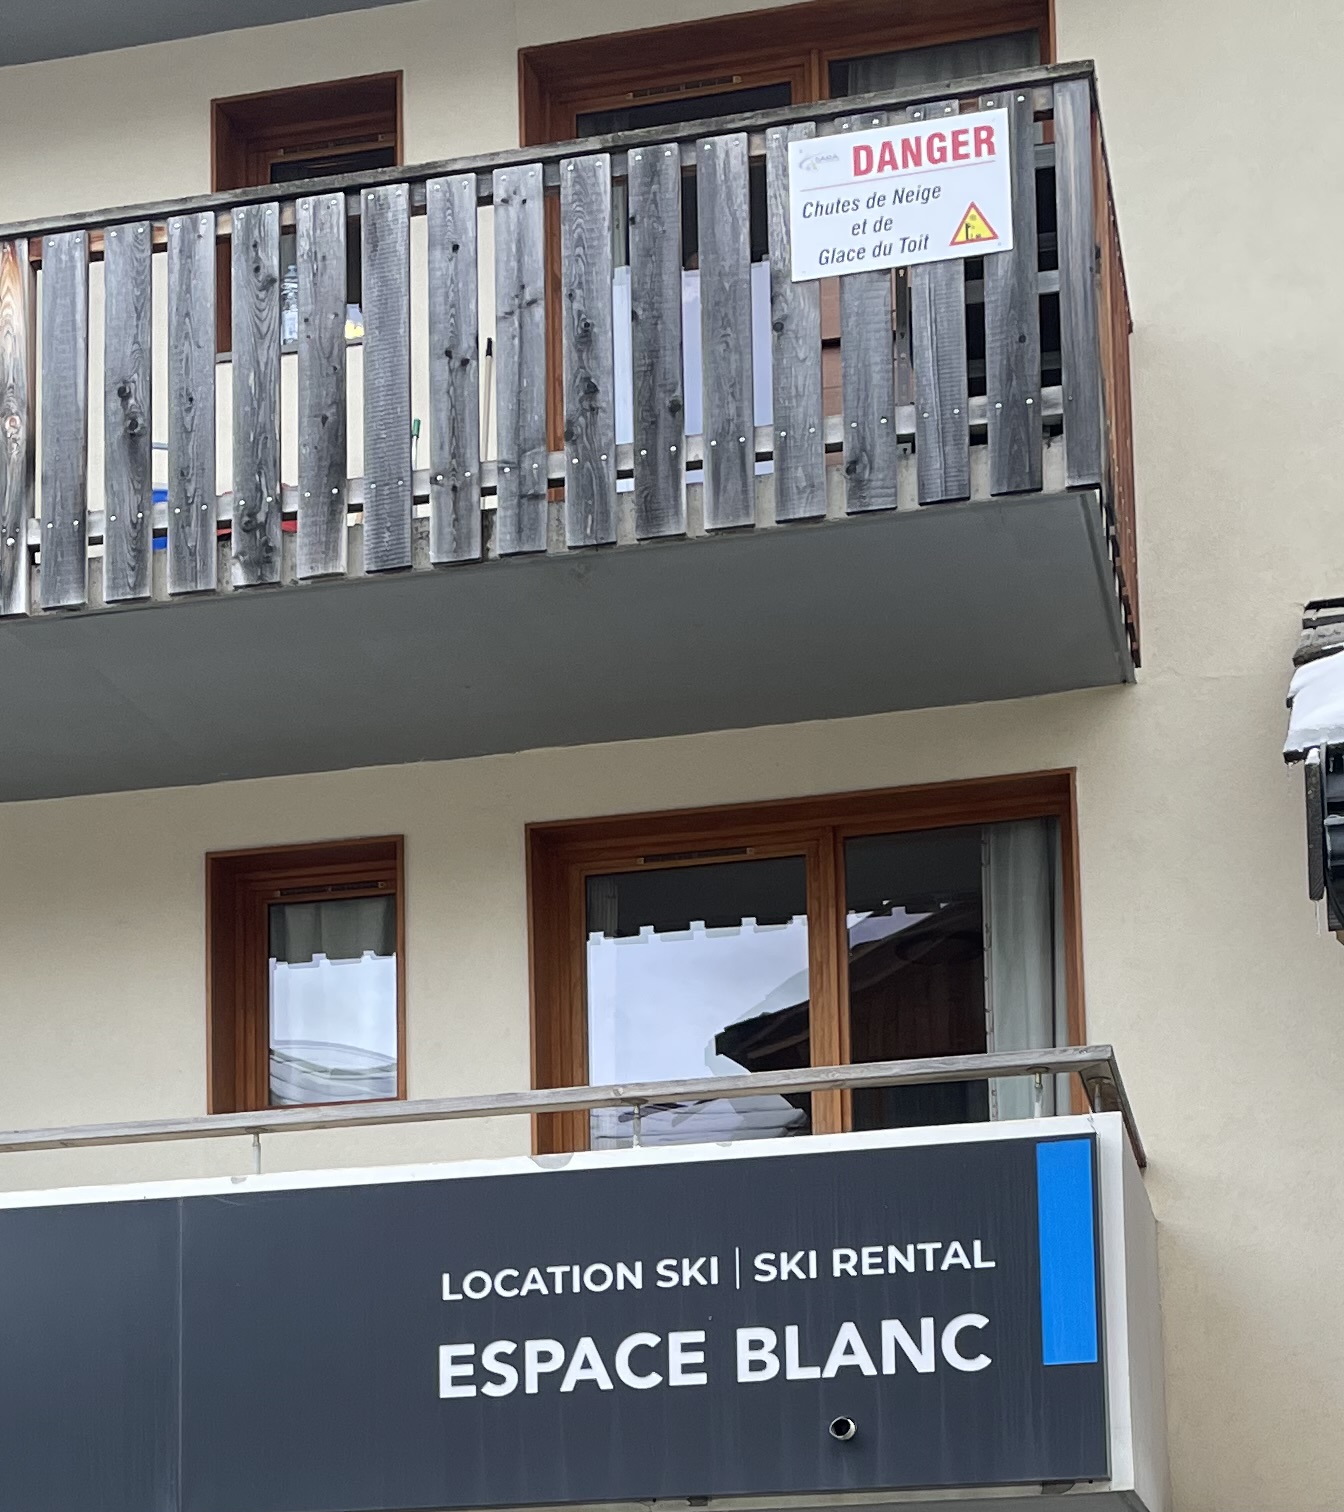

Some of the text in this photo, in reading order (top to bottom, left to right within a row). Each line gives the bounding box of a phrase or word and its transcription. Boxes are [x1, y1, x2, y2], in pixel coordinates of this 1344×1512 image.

[852, 124, 997, 177] DANGER
[802, 184, 942, 219] Chutes de Neige
[851, 215, 893, 236] et de
[818, 234, 929, 266] Glace du Toit
[441, 1239, 996, 1301] LOCATION SKI SKI RENTAL
[438, 1313, 993, 1399] ESPACE BLANC
